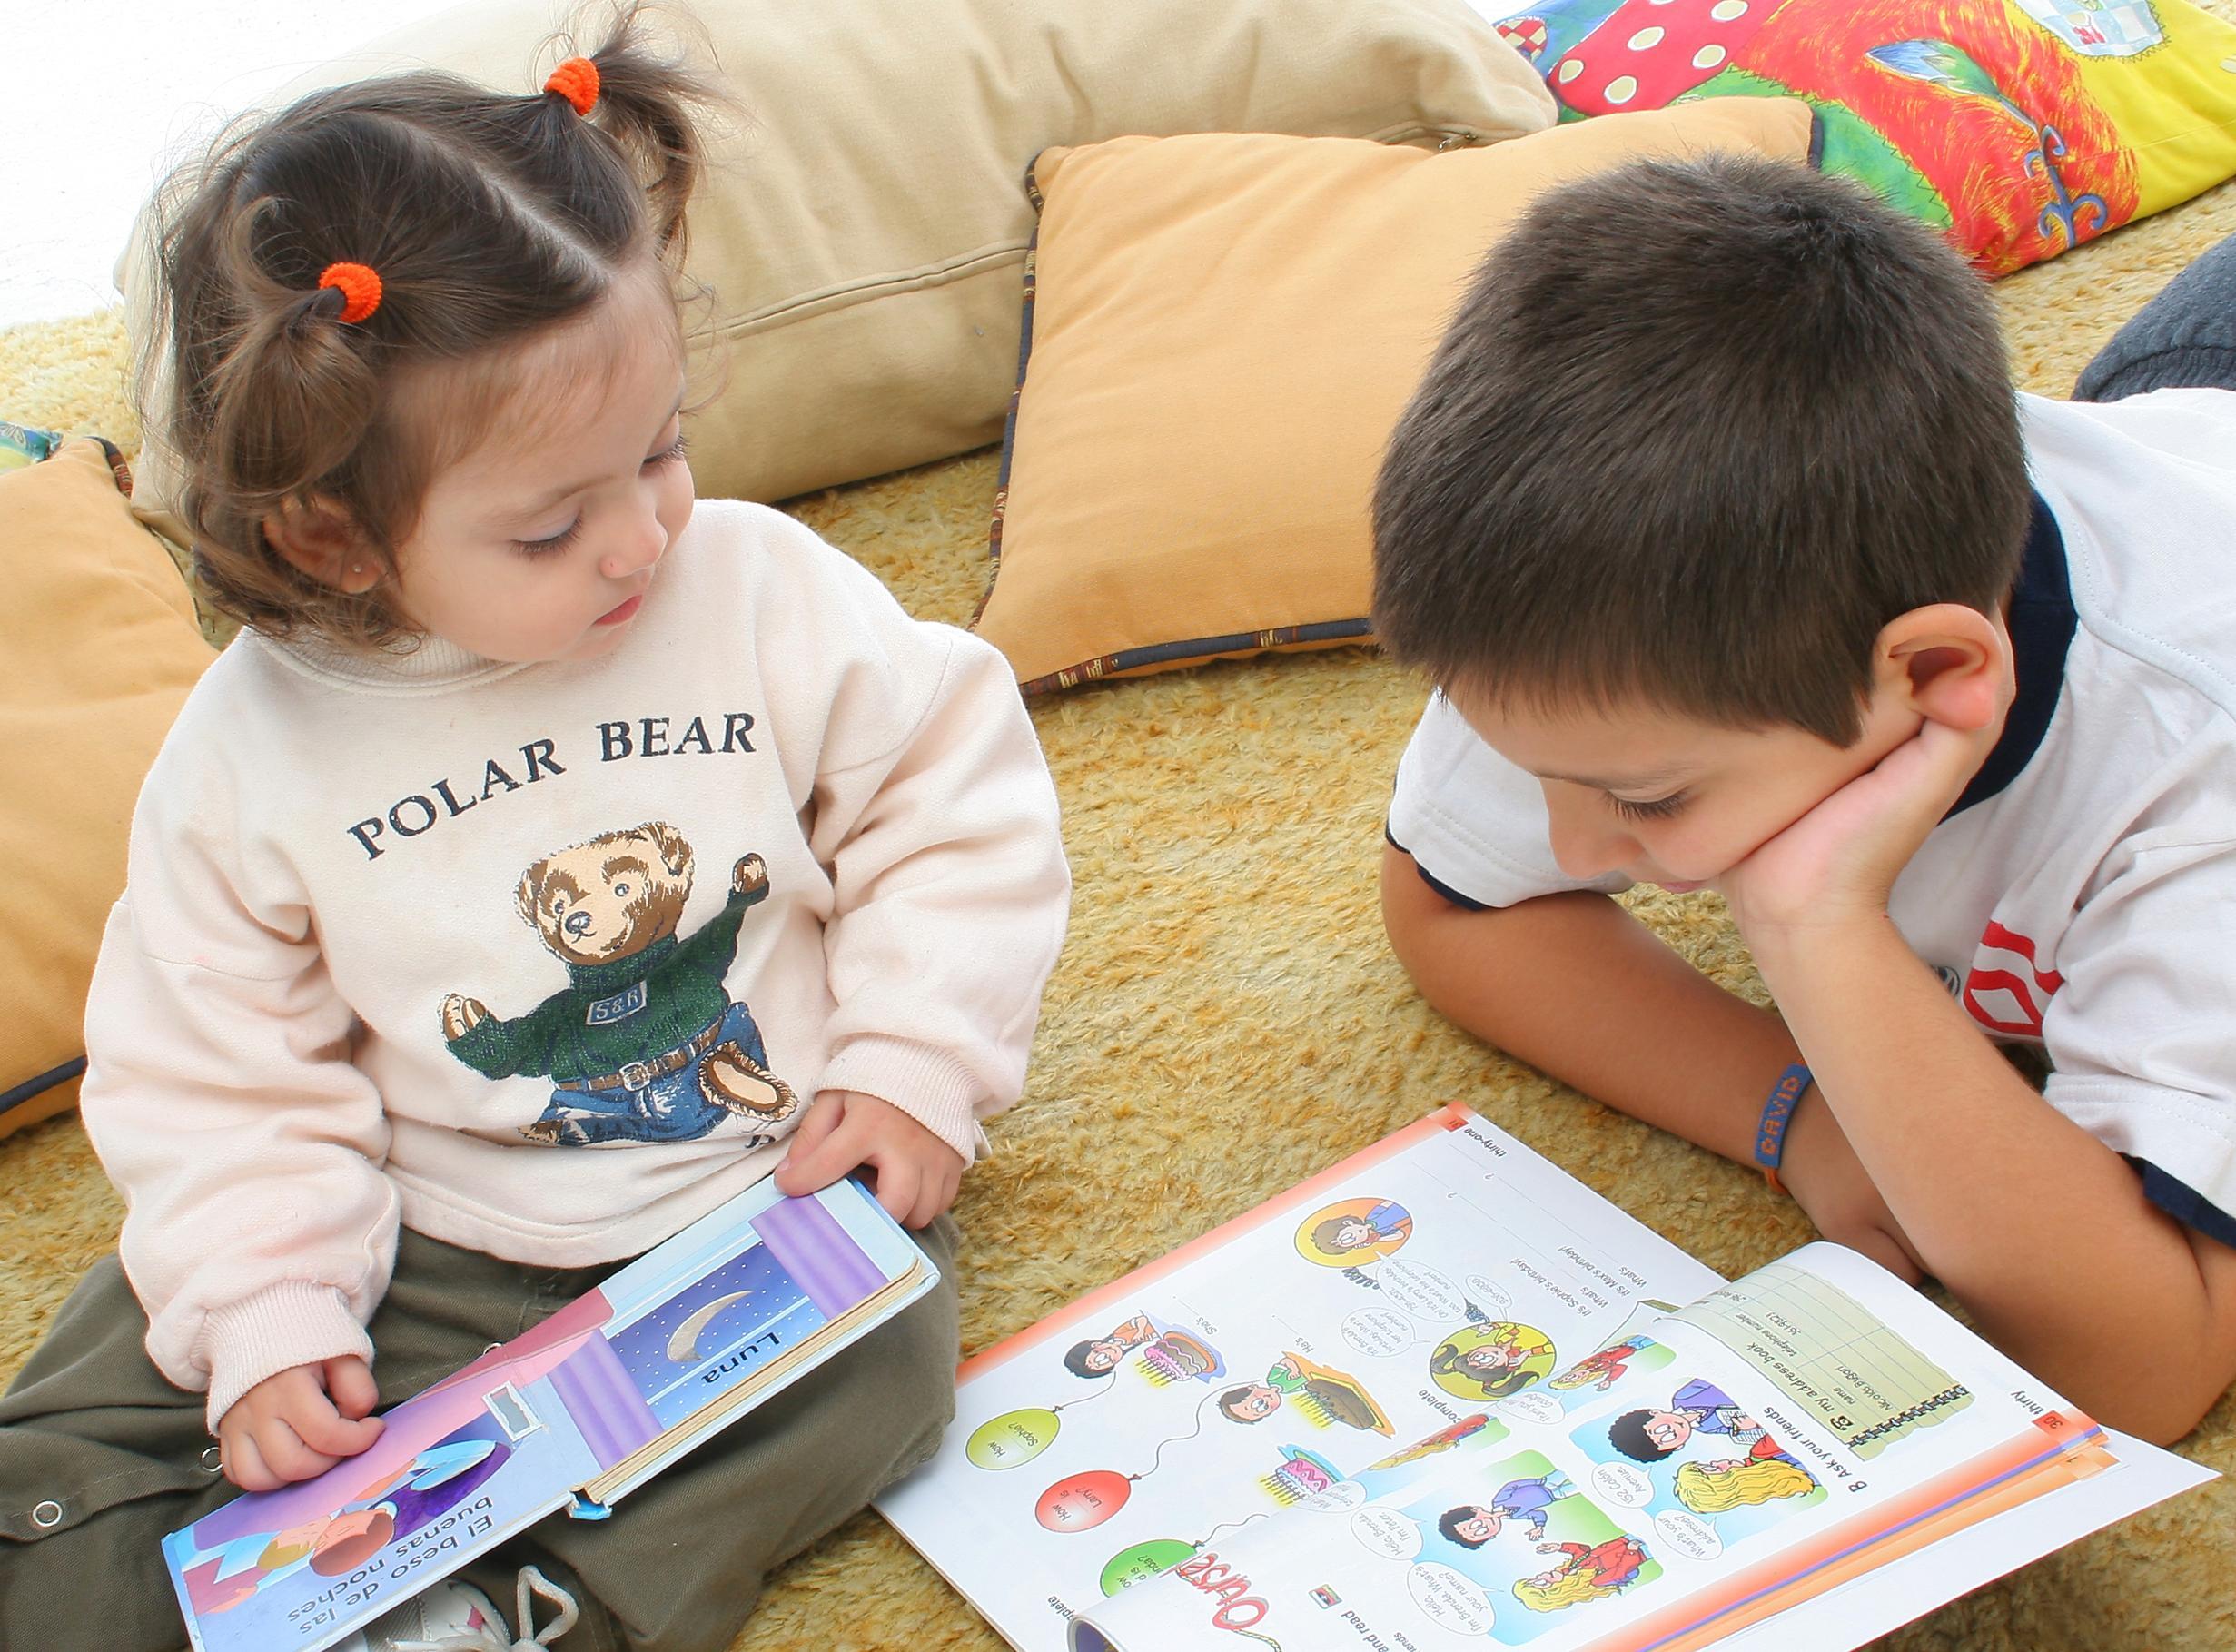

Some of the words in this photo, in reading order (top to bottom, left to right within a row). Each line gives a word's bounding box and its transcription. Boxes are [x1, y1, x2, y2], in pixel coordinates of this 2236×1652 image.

[346, 737, 567, 861] POLAR
[596, 712, 757, 762] BEAR
[595, 988, 640, 1021] S&R
[1760, 1075, 1802, 1156] DAVID
[1463, 1125, 1506, 1158] thirty-one
[701, 1331, 780, 1383] Luna
[1746, 1340, 1774, 1362] book
[1772, 1361, 1817, 1399] address
[1814, 1396, 1834, 1412] my
[2009, 1390, 2043, 1416] thirty
[1008, 1422, 1038, 1446] Sophie?
[1761, 1405, 1803, 1440] friends
[2043, 1414, 2063, 1429] 30
[988, 1440, 1005, 1457] How
[1800, 1438, 1831, 1459] your
[1825, 1459, 1852, 1478] Ask
[1052, 1503, 1071, 1521] How
[396, 1497, 494, 1556] buenas
[469, 1514, 493, 1538] El
[391, 1536, 459, 1578] beso
[1136, 1555, 1163, 1573] nda?
[288, 1559, 385, 1621] noches
[345, 1582, 379, 1606] de
[300, 1607, 336, 1634] las
[1340, 1609, 1370, 1634] read
